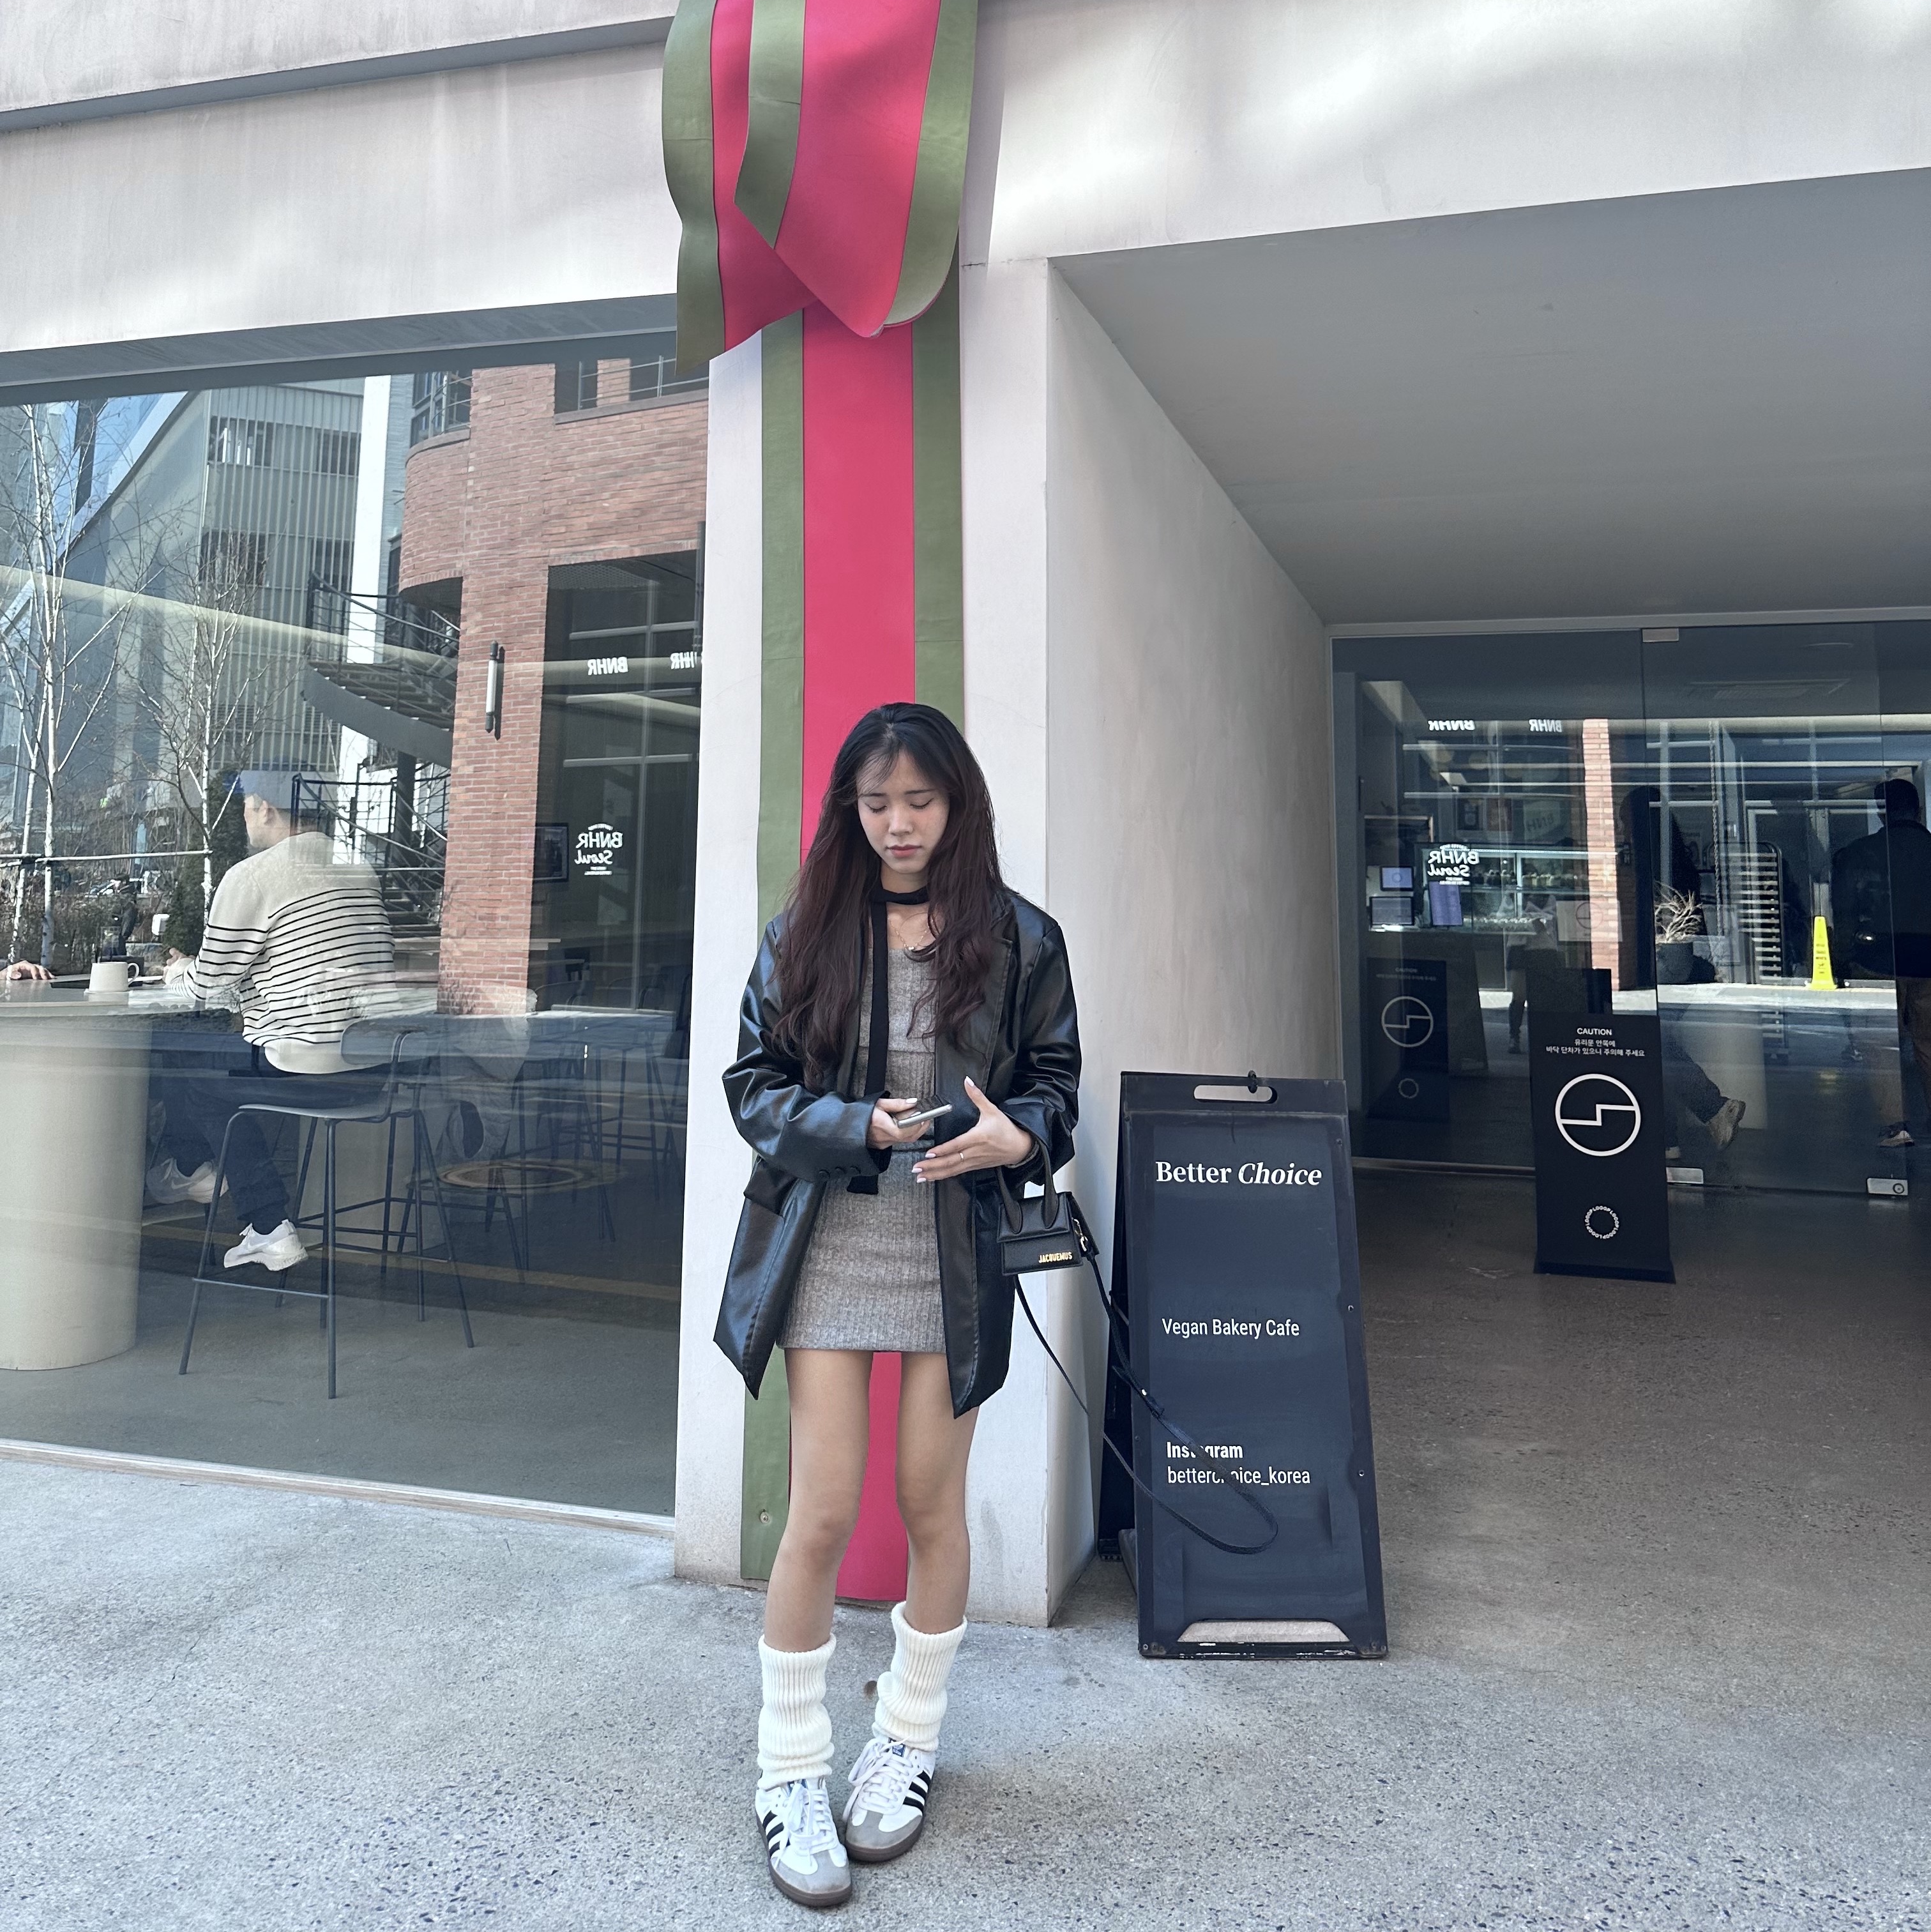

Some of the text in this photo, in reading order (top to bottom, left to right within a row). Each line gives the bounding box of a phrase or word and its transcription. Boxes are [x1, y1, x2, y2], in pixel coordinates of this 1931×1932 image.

[1155, 1161, 1322, 1185] Better Choice
[1038, 1252, 1073, 1263] JACQUEMUS
[1162, 1318, 1299, 1339] Vegan Bakery Cafe
[1167, 1441, 1243, 1458] Insgram
[1168, 1466, 1310, 1486] bettercoice_korea
